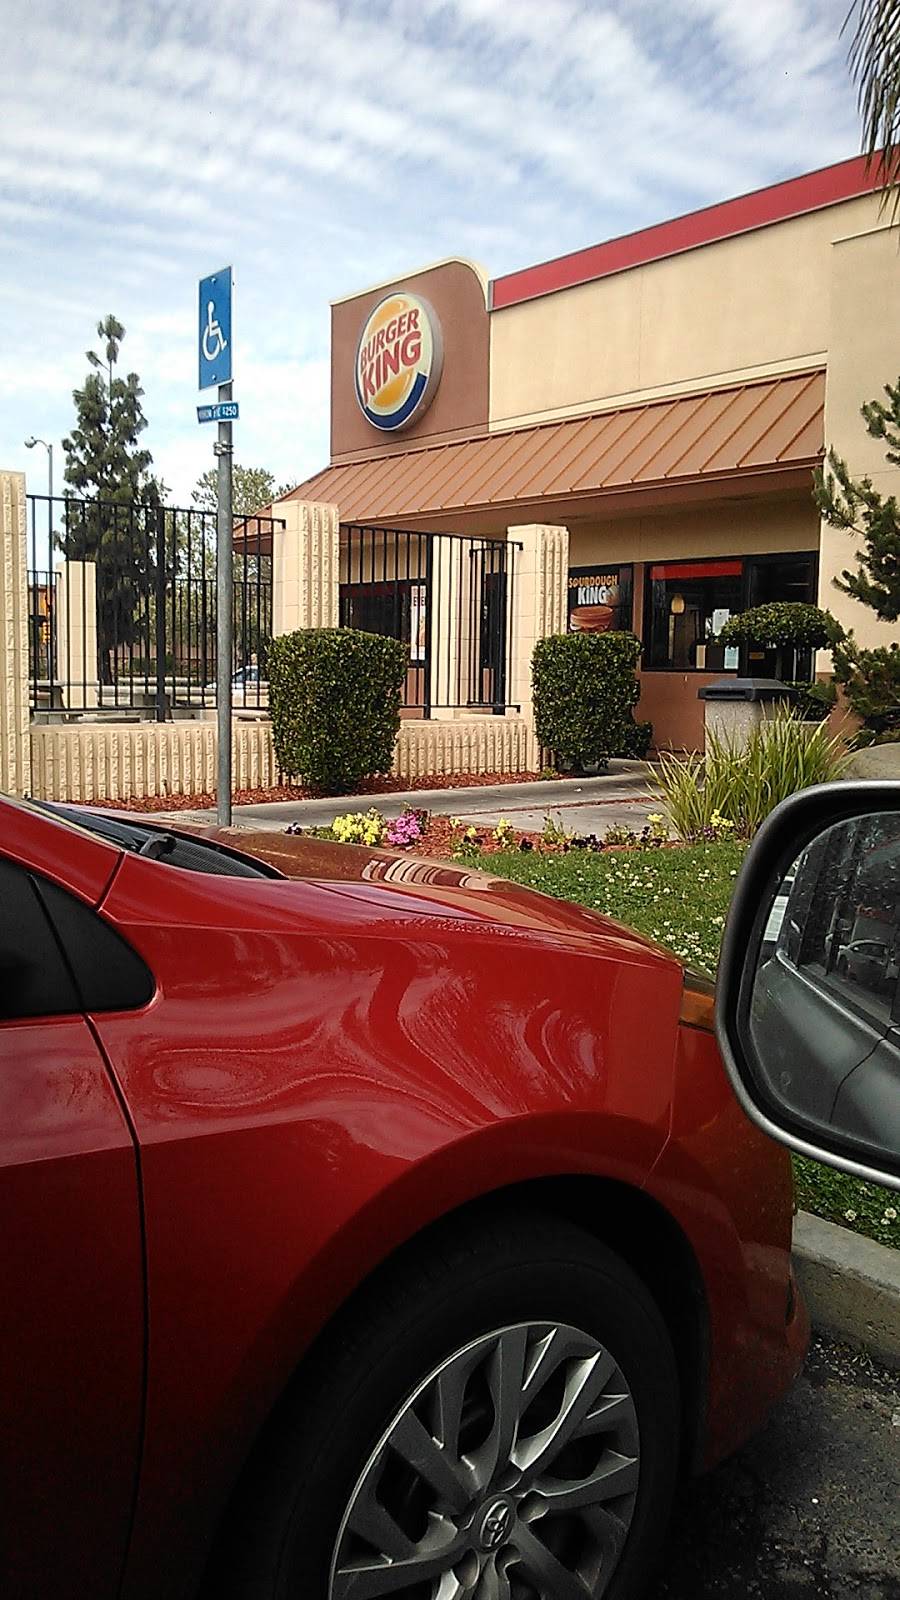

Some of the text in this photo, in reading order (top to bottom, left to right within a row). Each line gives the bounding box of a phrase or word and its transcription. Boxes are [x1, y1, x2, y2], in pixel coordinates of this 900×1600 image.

[361, 308, 419, 374] BURGER
[362, 330, 422, 405] KING
[568, 574, 618, 588] SOURDOUGH
[577, 585, 608, 605] KING
